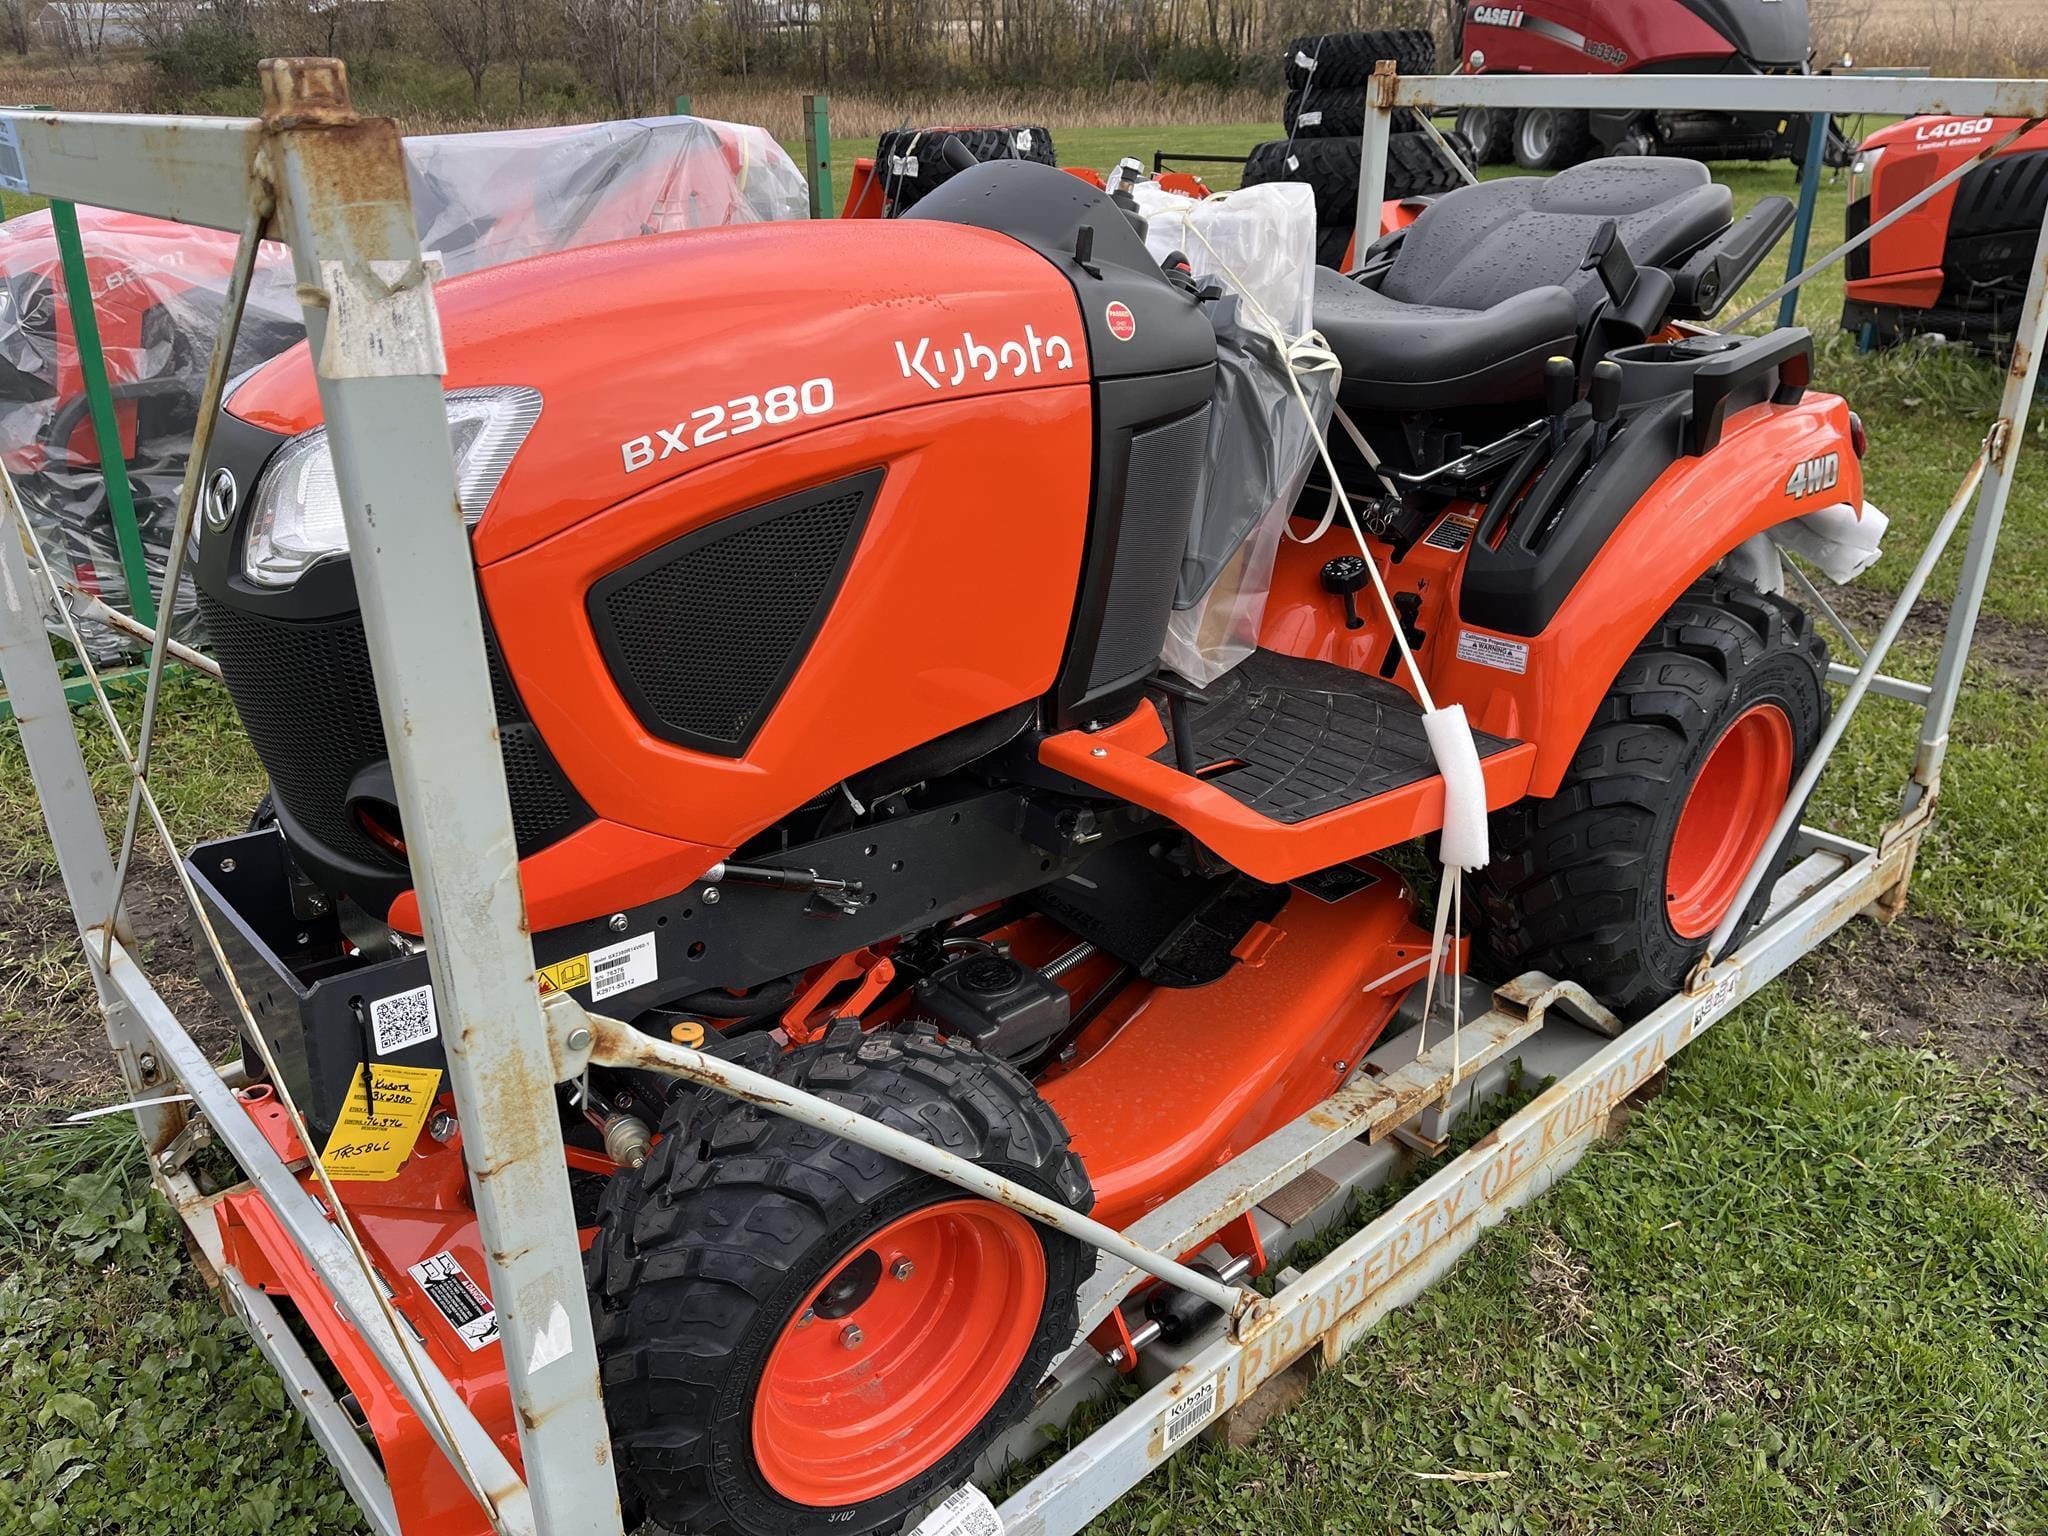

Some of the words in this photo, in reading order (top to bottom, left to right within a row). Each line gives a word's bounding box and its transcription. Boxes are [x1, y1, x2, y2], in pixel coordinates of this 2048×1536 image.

[1474, 6, 1510, 27] CASE
[1915, 117, 1994, 141] L4060
[1916, 140, 1948, 151] Limited
[1948, 136, 1982, 147] Edition
[893, 323, 1074, 390] Kubota
[620, 377, 836, 474] BX2380
[1785, 450, 1840, 501] 4WD
[1464, 633, 1487, 642] California
[1488, 638, 1515, 649] Proposition
[1478, 642, 1507, 654] WARNING
[1236, 1186, 1466, 1398] PROPERTY
[1480, 1140, 1527, 1200] OF
[1539, 1033, 1665, 1153] KUBOTA
[466, 1283, 487, 1307] DANGER
[1171, 1383, 1212, 1417] Kubota
